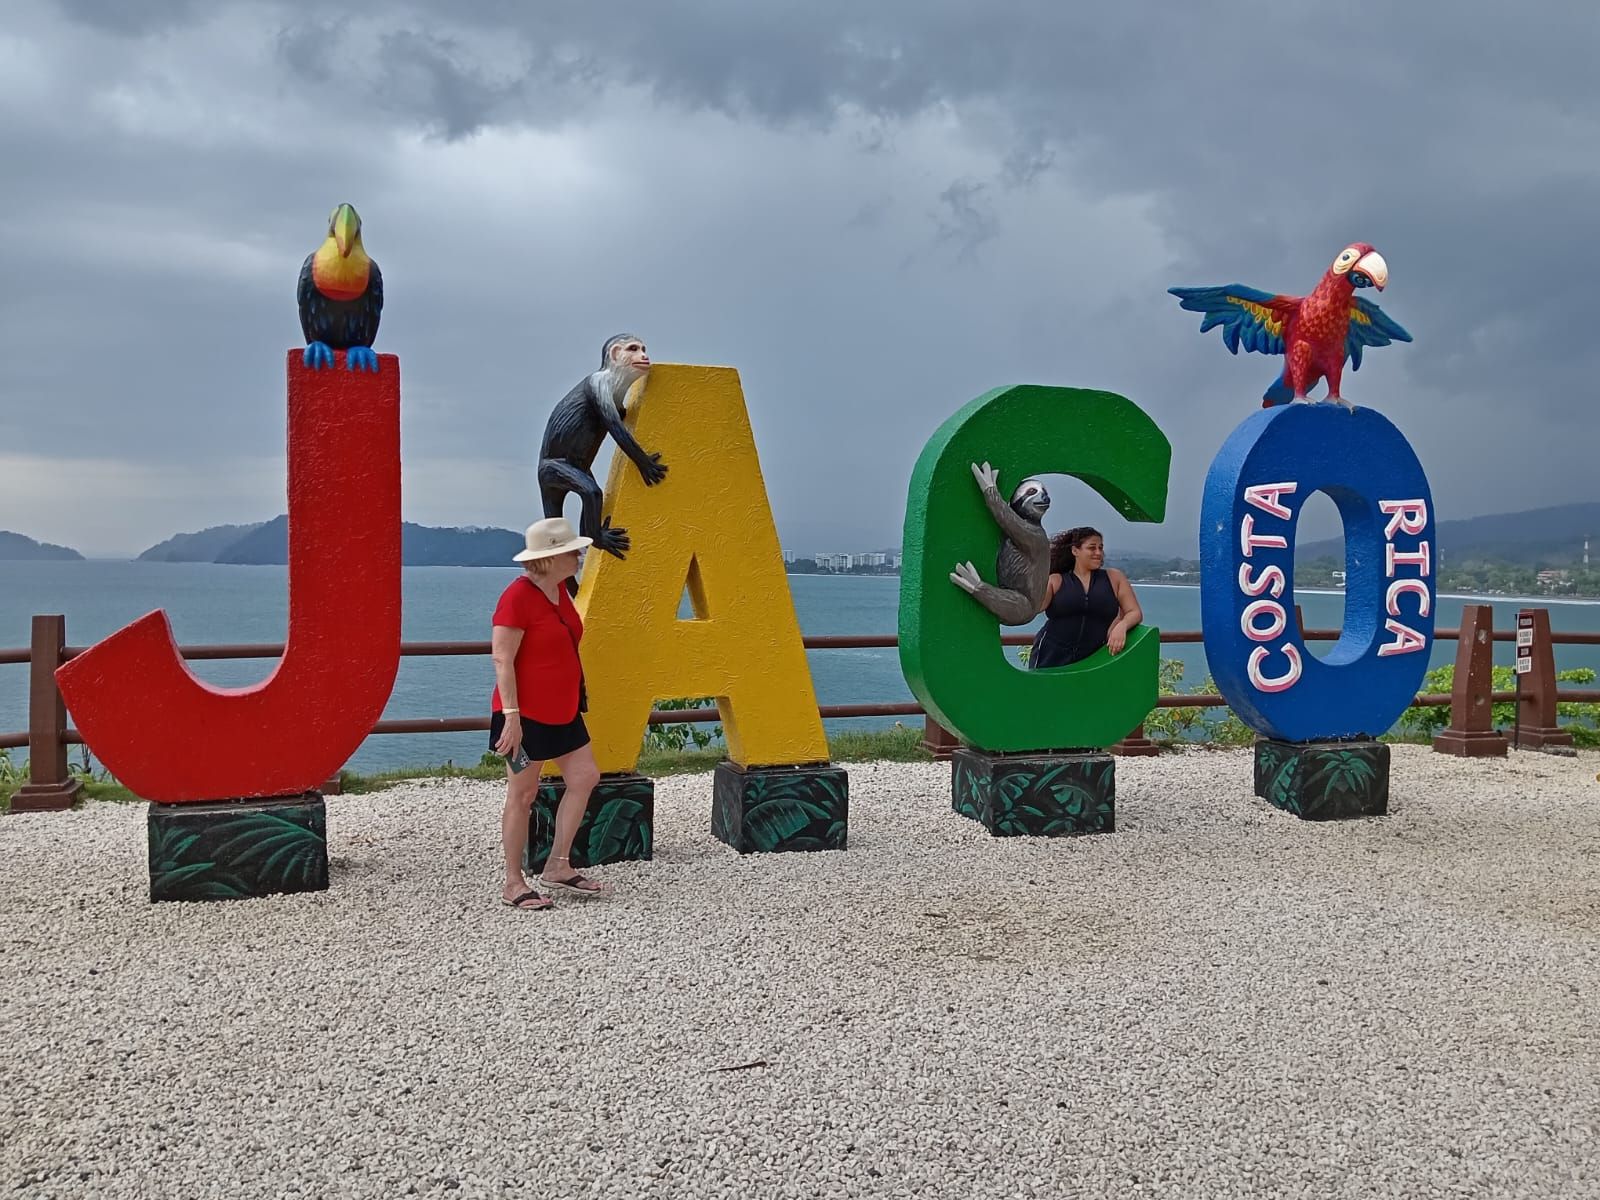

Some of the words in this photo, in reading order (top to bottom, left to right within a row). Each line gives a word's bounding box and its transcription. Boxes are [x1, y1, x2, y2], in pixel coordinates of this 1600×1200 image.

[56, 349, 1437, 803] JACO
[1238, 482, 1303, 693] COSTA
[1377, 499, 1430, 657] RICA
